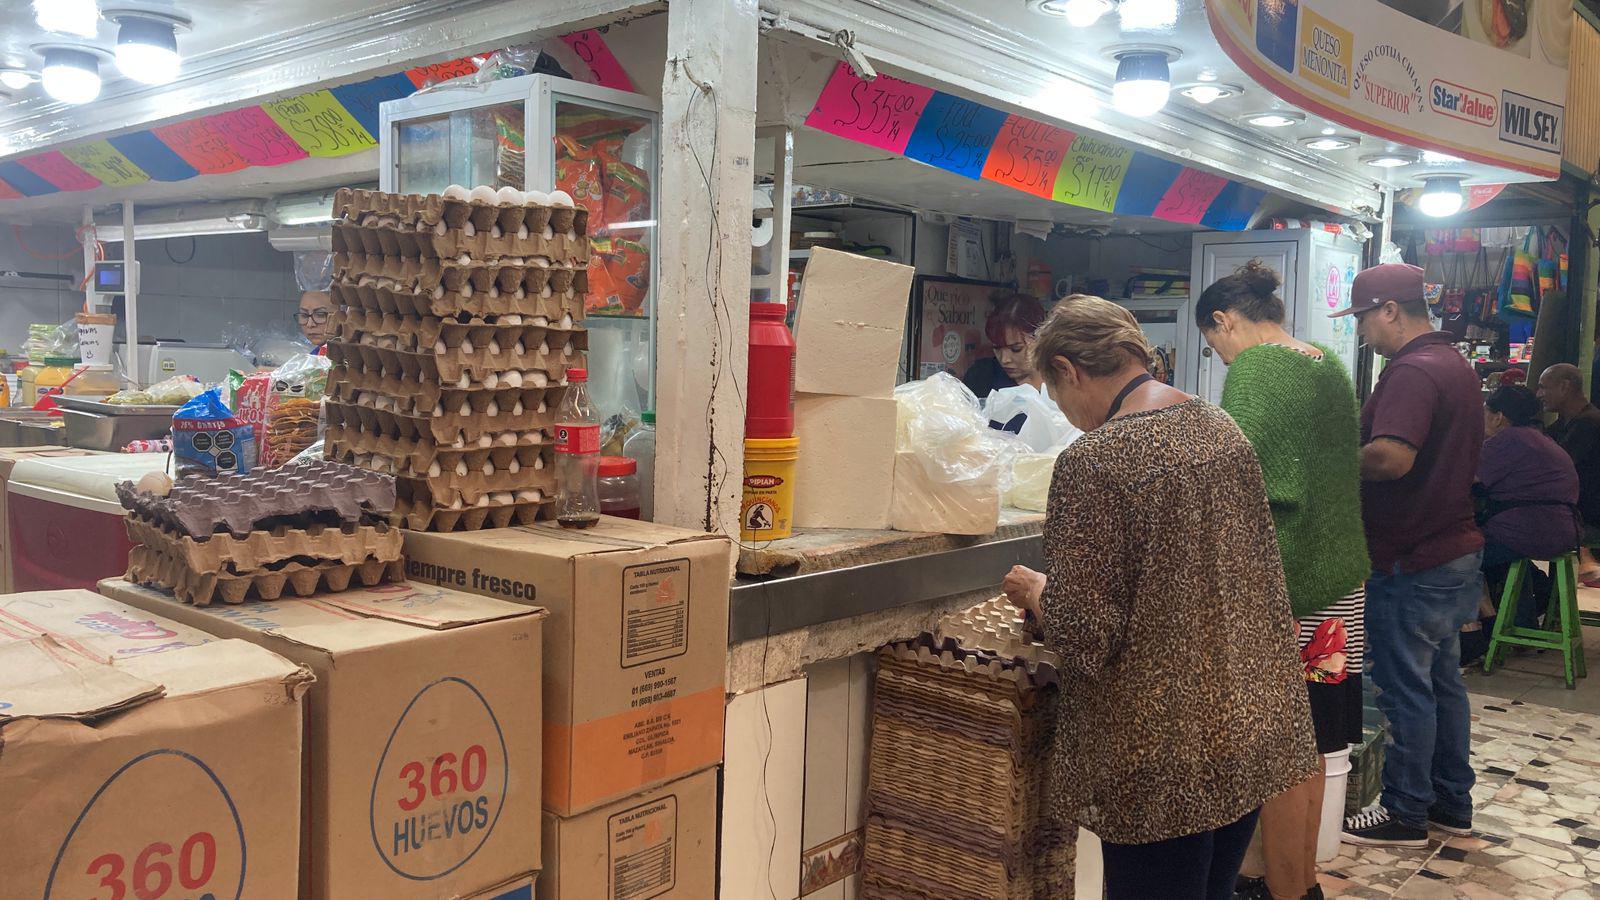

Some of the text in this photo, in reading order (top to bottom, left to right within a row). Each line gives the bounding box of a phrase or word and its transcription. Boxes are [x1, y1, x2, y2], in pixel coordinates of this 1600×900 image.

[1313, 27, 1340, 57] QUESO
[1303, 46, 1347, 86] MENONITA
[472, 568, 537, 601] fresco
[650, 566, 680, 574] NUTRICIONAL
[645, 668, 666, 679] VENTAS
[631, 699, 638, 707] 01
[632, 687, 638, 695] 01
[398, 744, 487, 811] 360
[394, 796, 488, 856] HUEVOS
[619, 803, 667, 825] TABLA NUTRICIONAL
[86, 832, 216, 900] 360
